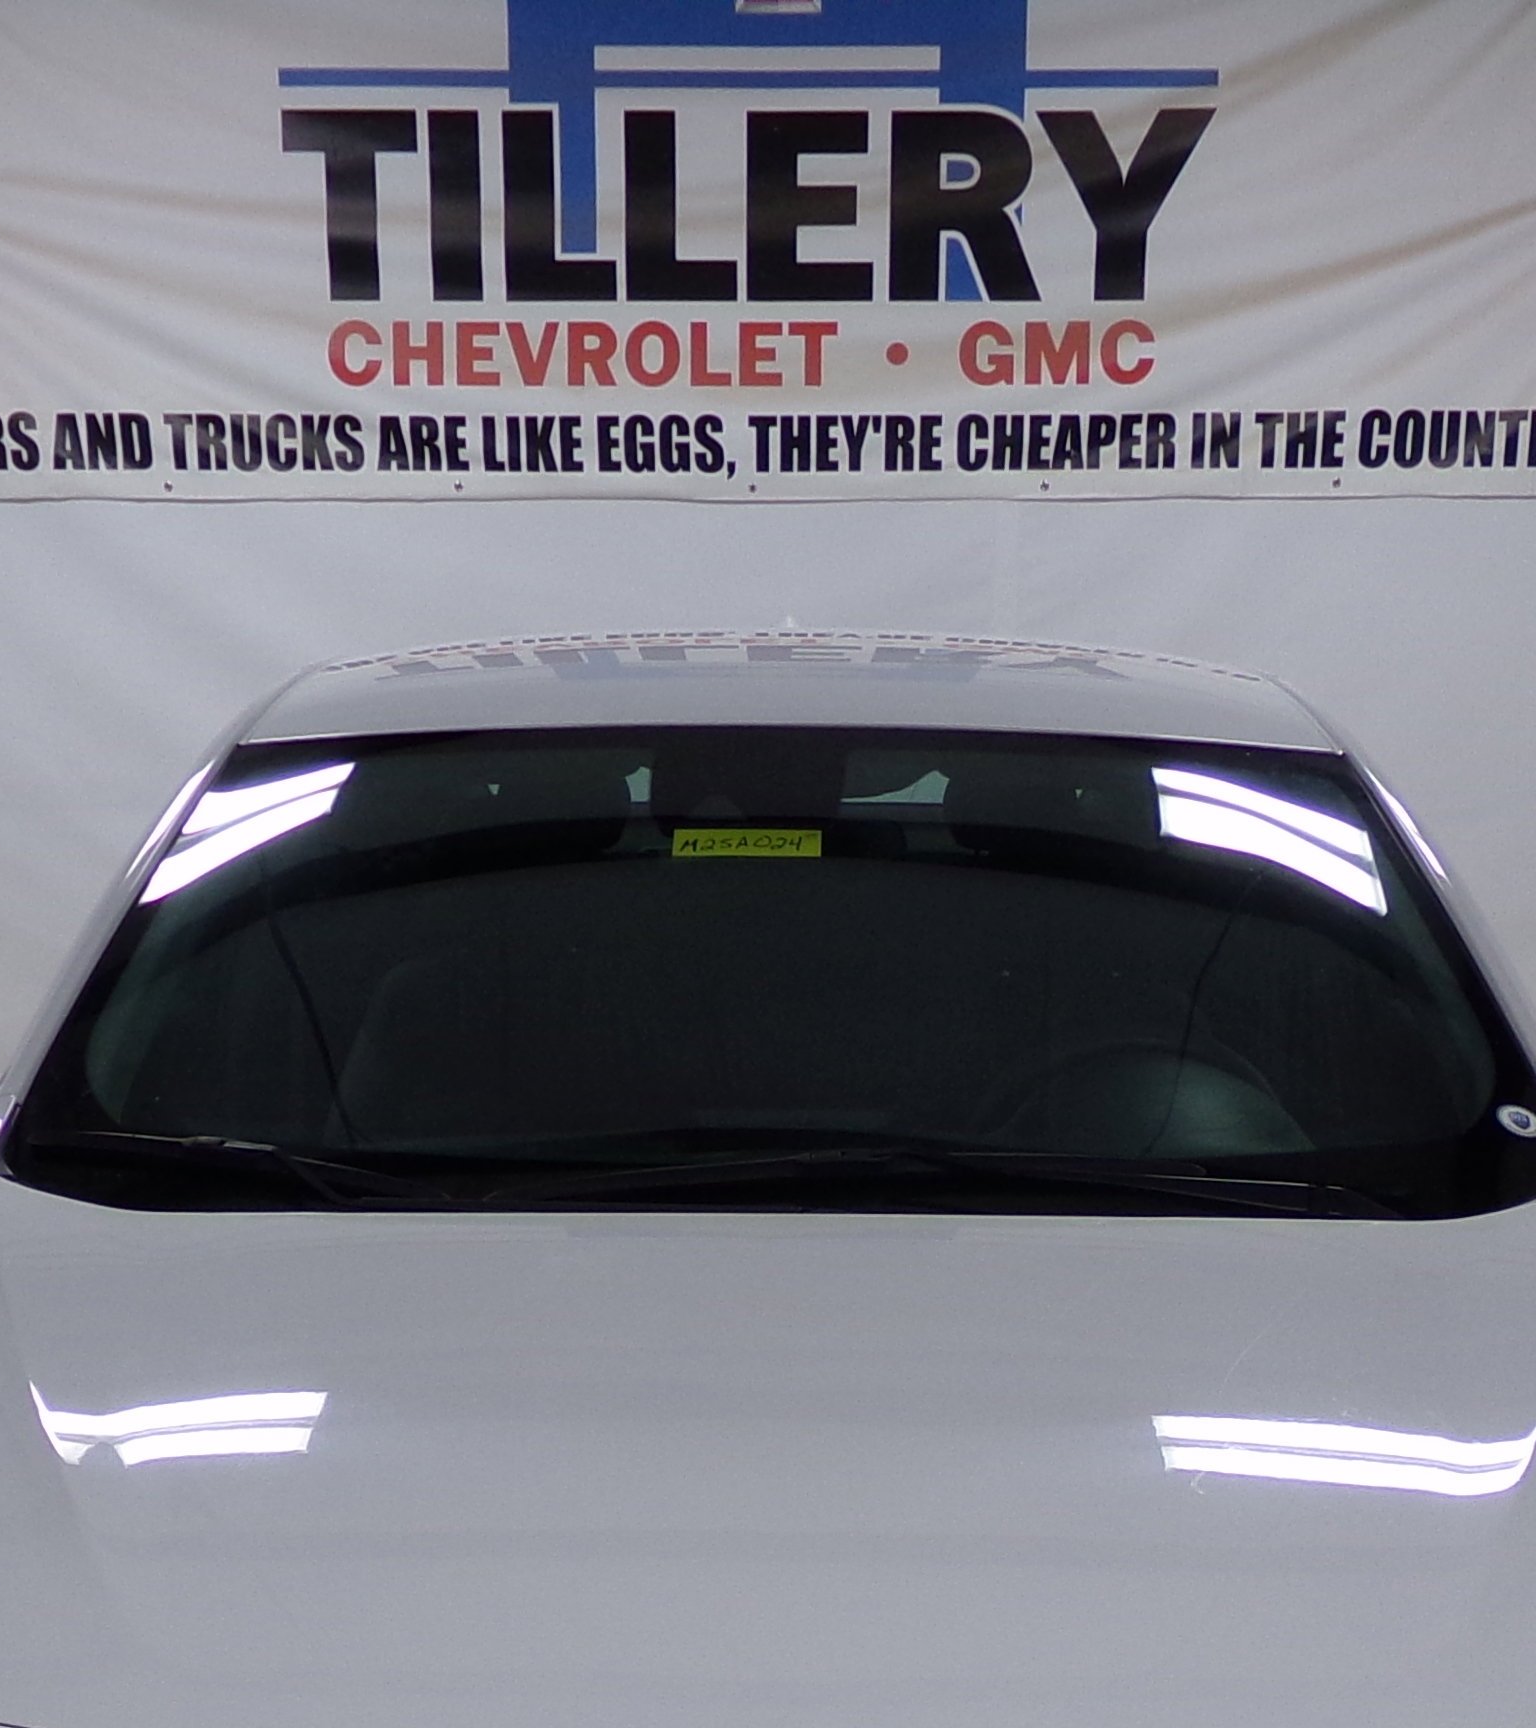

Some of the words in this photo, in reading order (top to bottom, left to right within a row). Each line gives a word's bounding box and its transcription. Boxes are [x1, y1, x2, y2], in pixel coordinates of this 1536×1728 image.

[280, 107, 1218, 302] TILLERY
[327, 320, 838, 388] CHEVROLET
[957, 320, 1156, 387] GMC
[52, 412, 154, 472] AND
[164, 412, 365, 473] TRUCKS
[376, 414, 471, 473] ARE
[481, 414, 584, 473] LIKE
[597, 413, 738, 480] EGGS,
[747, 414, 943, 473] THEY'RE
[956, 411, 1177, 472] CHEAPER
[1190, 411, 1241, 469] IN
[1254, 410, 1346, 469] THE
